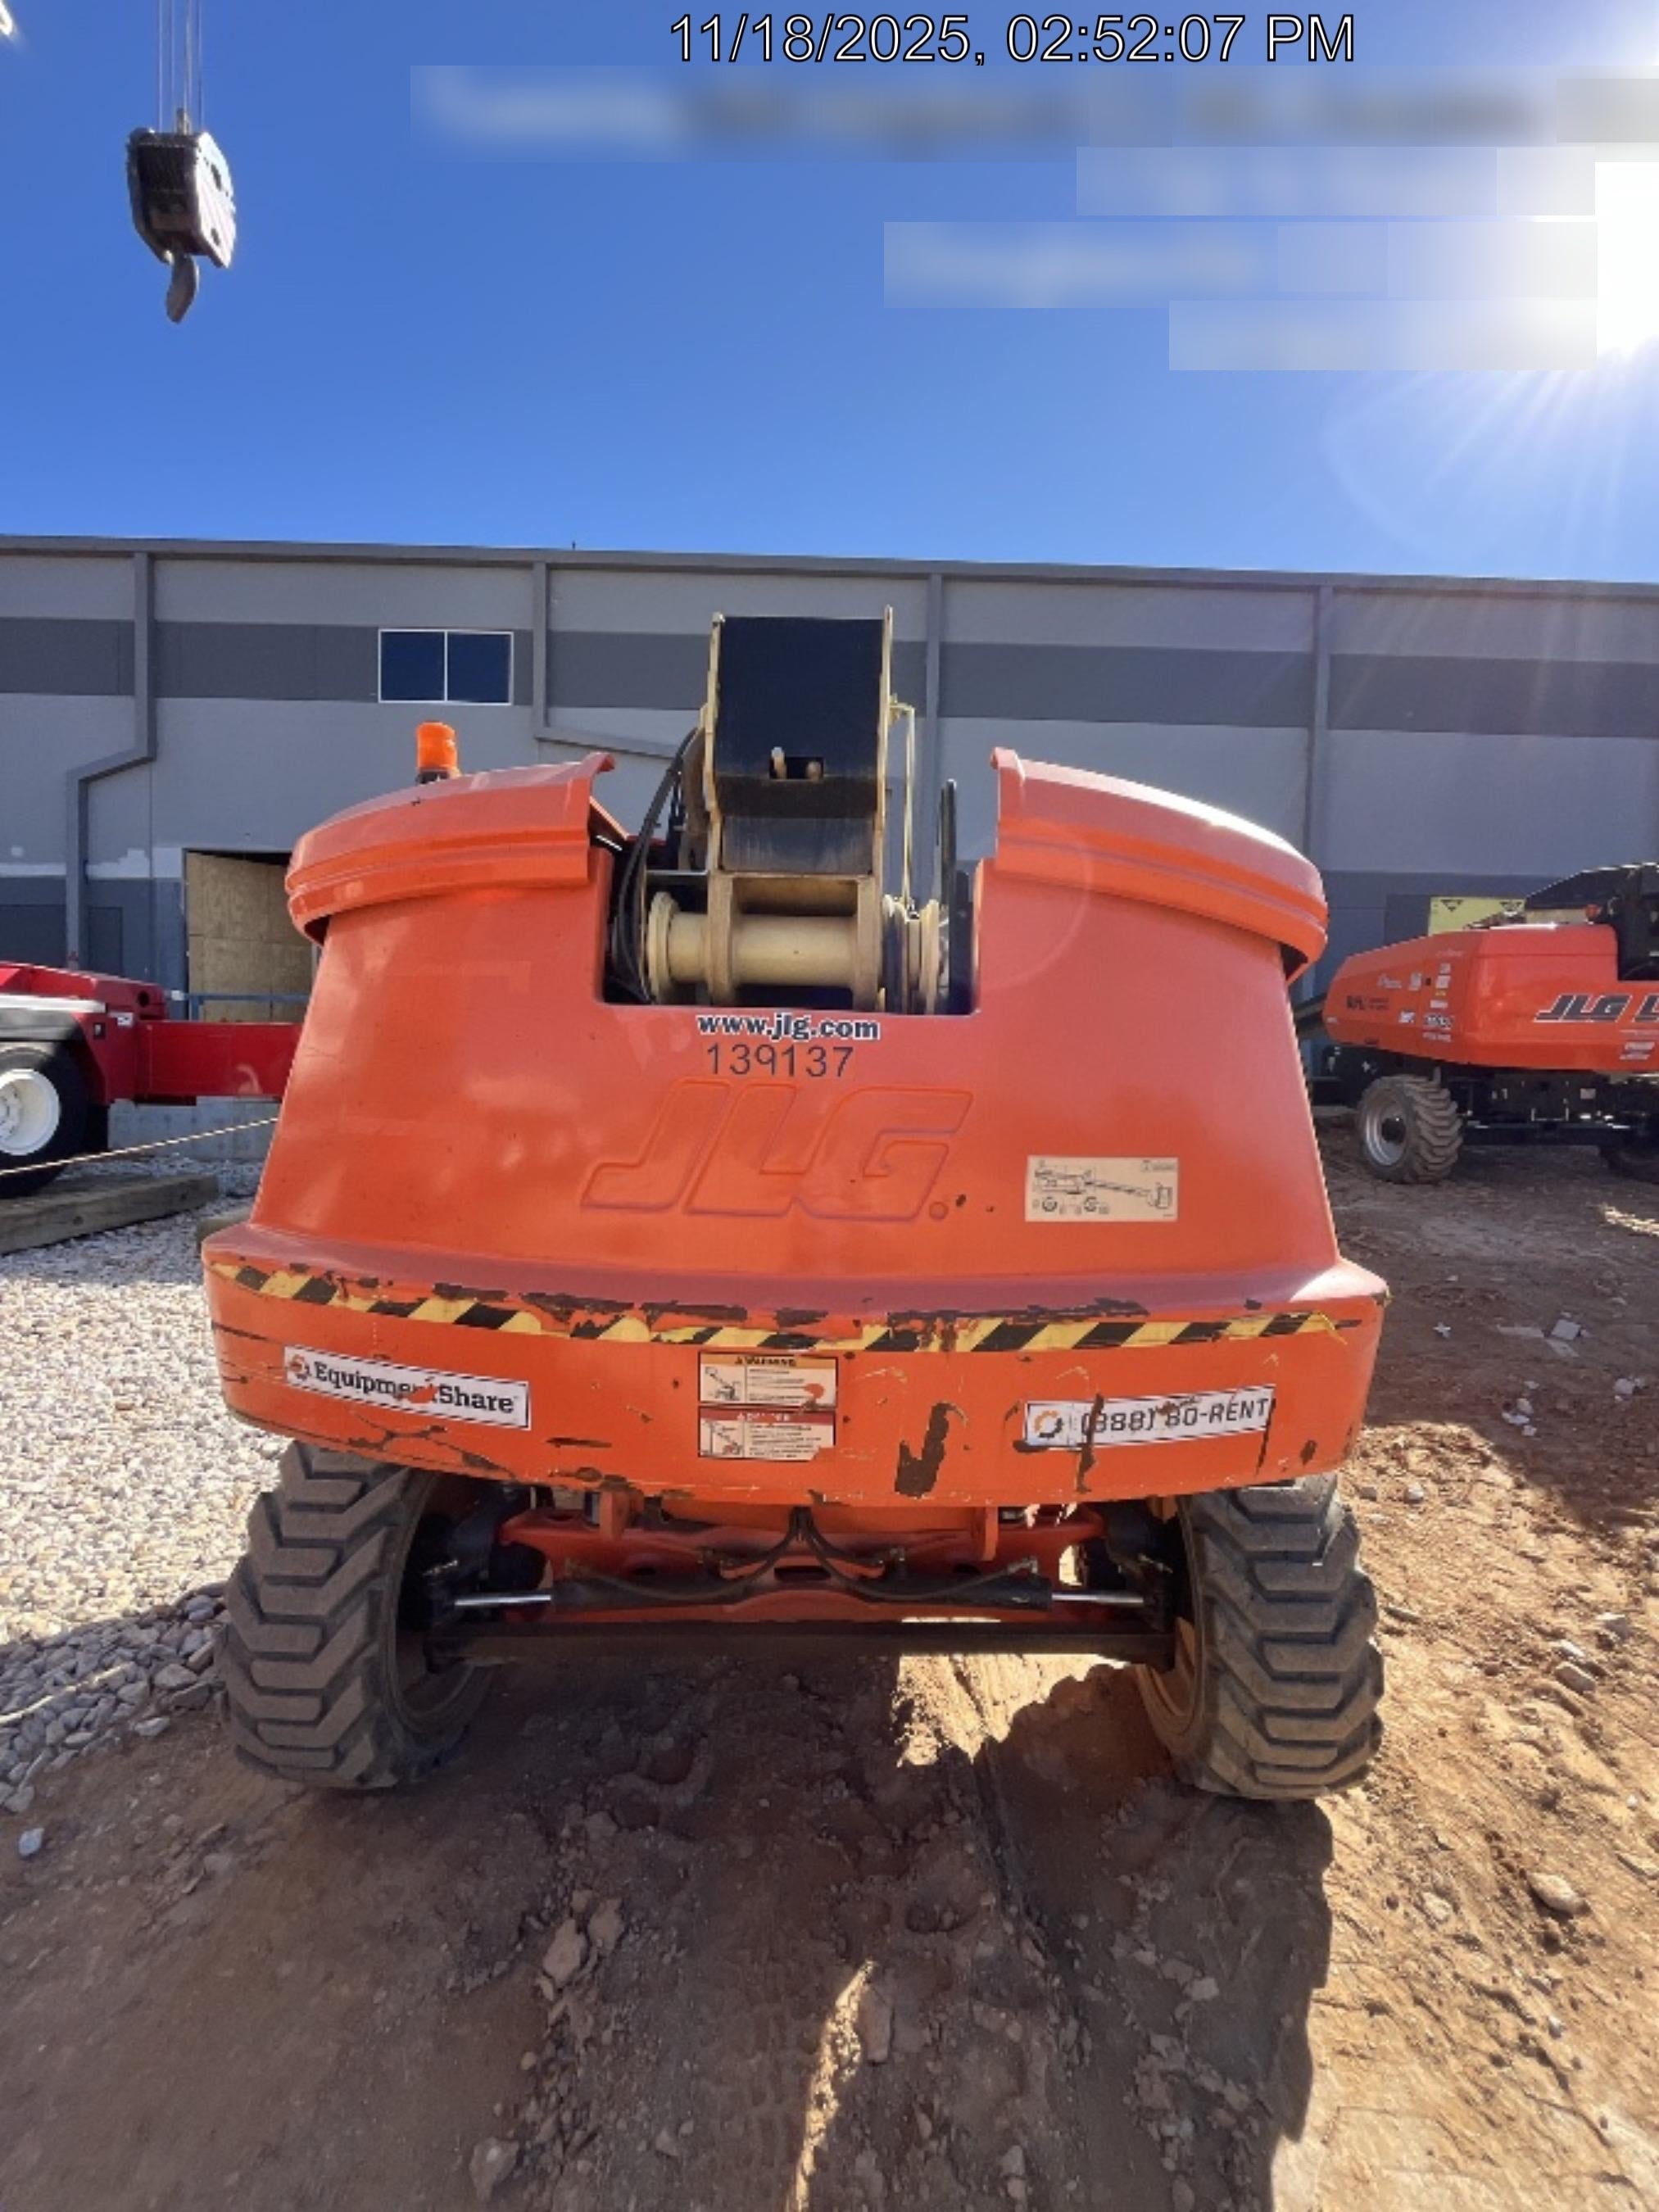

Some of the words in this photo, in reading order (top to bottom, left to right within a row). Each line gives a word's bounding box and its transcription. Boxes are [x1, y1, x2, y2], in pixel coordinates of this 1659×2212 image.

[1533, 994, 1633, 1023] JLG
[696, 1013, 882, 1041] www.jlg.com
[707, 1042, 854, 1078] 139137
[581, 1079, 973, 1222] JLG
